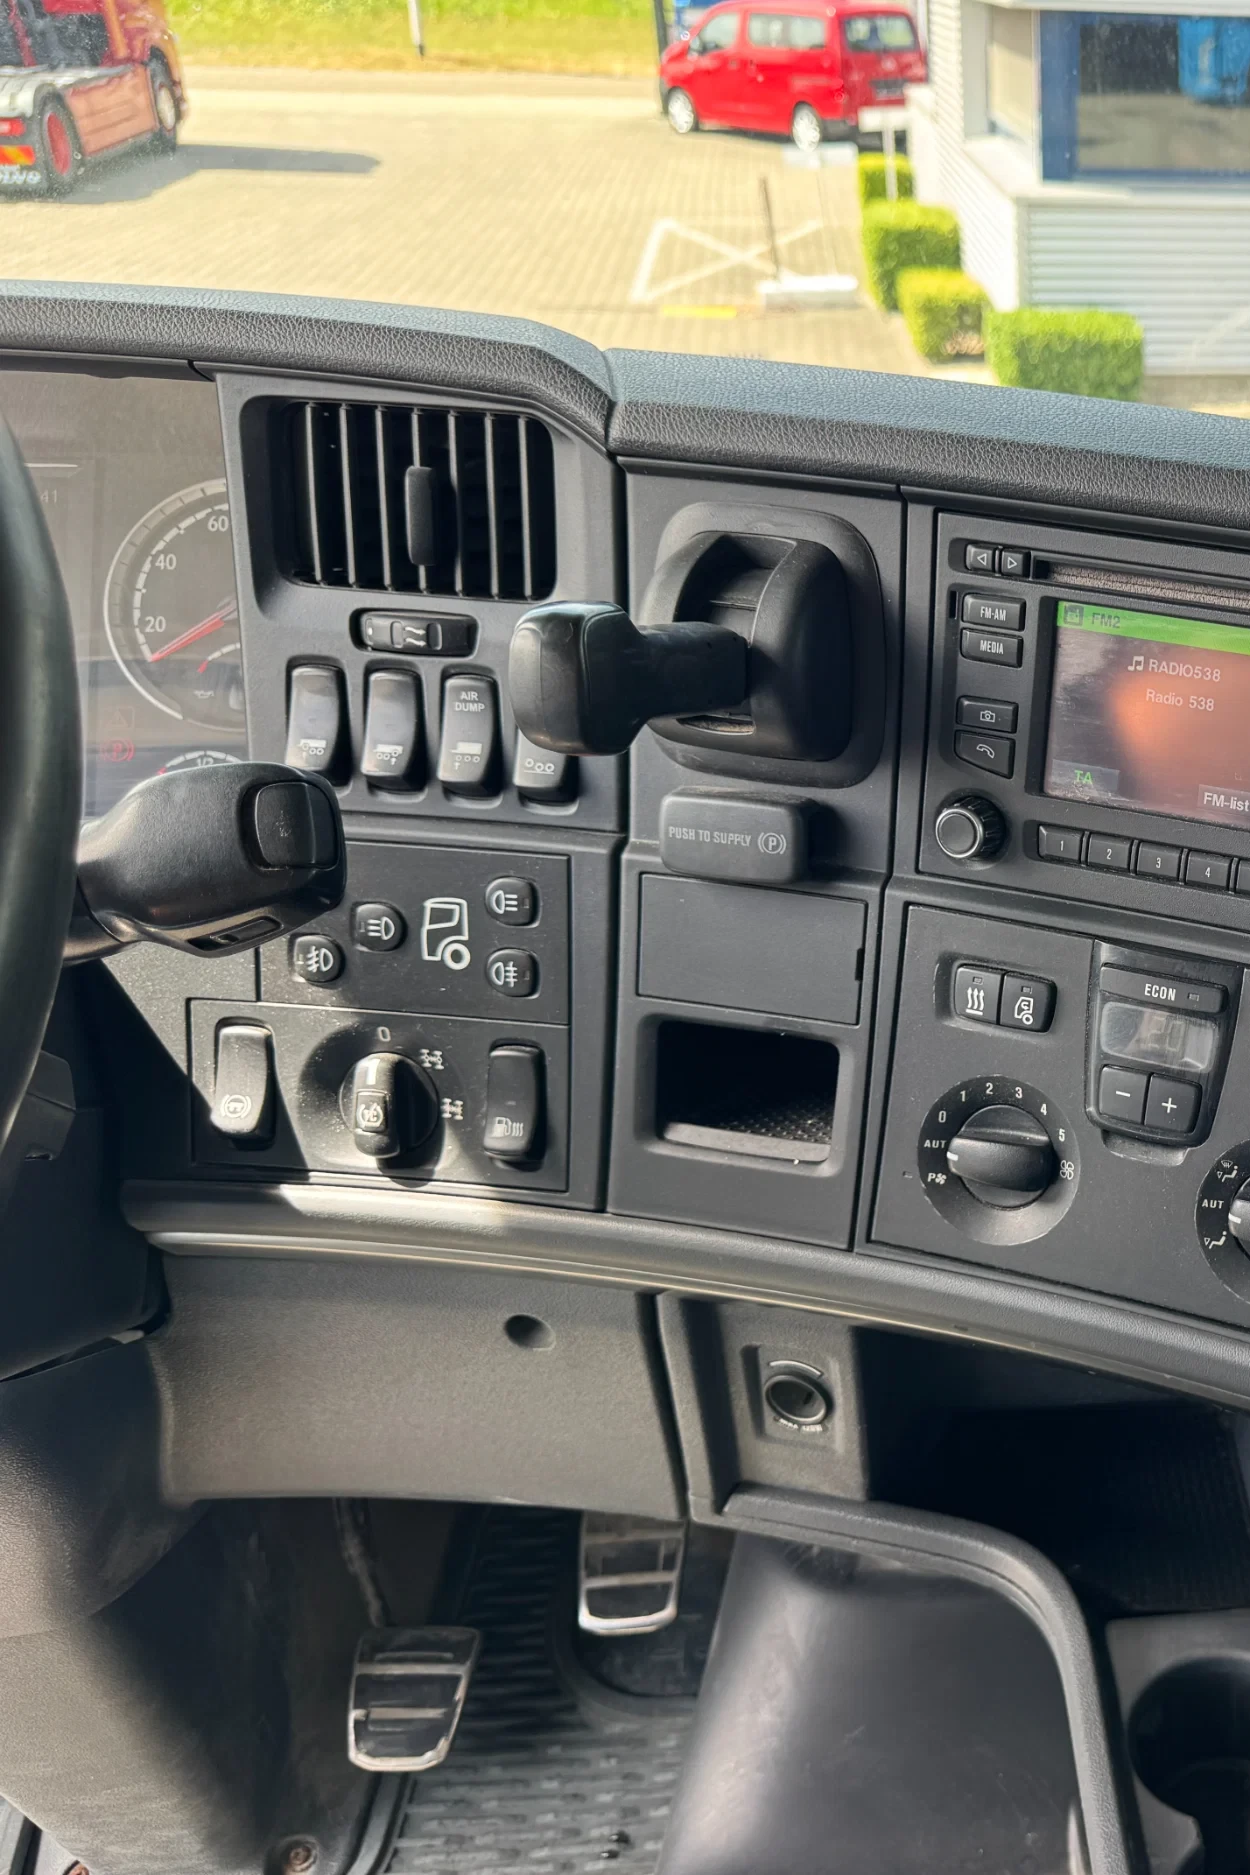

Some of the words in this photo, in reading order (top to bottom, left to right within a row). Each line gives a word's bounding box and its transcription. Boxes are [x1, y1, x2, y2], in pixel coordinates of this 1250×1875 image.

[207, 516, 228, 532] 60
[155, 553, 177, 570] 40
[980, 606, 1007, 622] FM-AM
[1091, 612, 1121, 628] FM2
[144, 616, 167, 632] 20
[979, 639, 1004, 655] MEDIA
[1148, 658, 1221, 682] RADIO538
[460, 691, 479, 701] AIR
[1146, 688, 1183, 707] Radio
[1188, 695, 1214, 711] 538
[454, 702, 485, 712] DUMP
[1074, 770, 1093, 785] TA
[669, 826, 695, 839] PUSH
[698, 829, 711, 842] TO
[712, 831, 752, 847] SUPPLY
[1060, 840, 1065, 852] 1
[1106, 848, 1113, 860] 2
[1155, 857, 1162, 869] 3
[1205, 866, 1211, 878] 4
[1144, 983, 1177, 1001] ECON
[986, 1082, 994, 1095] 2
[1015, 1087, 1023, 1099] 3
[960, 1090, 966, 1102] 1
[1040, 1103, 1048, 1116] 4
[938, 1110, 947, 1124] 0
[1058, 1128, 1066, 1142] 5
[923, 1139, 947, 1149] AUT
[1201, 1198, 1225, 1210] AUT
